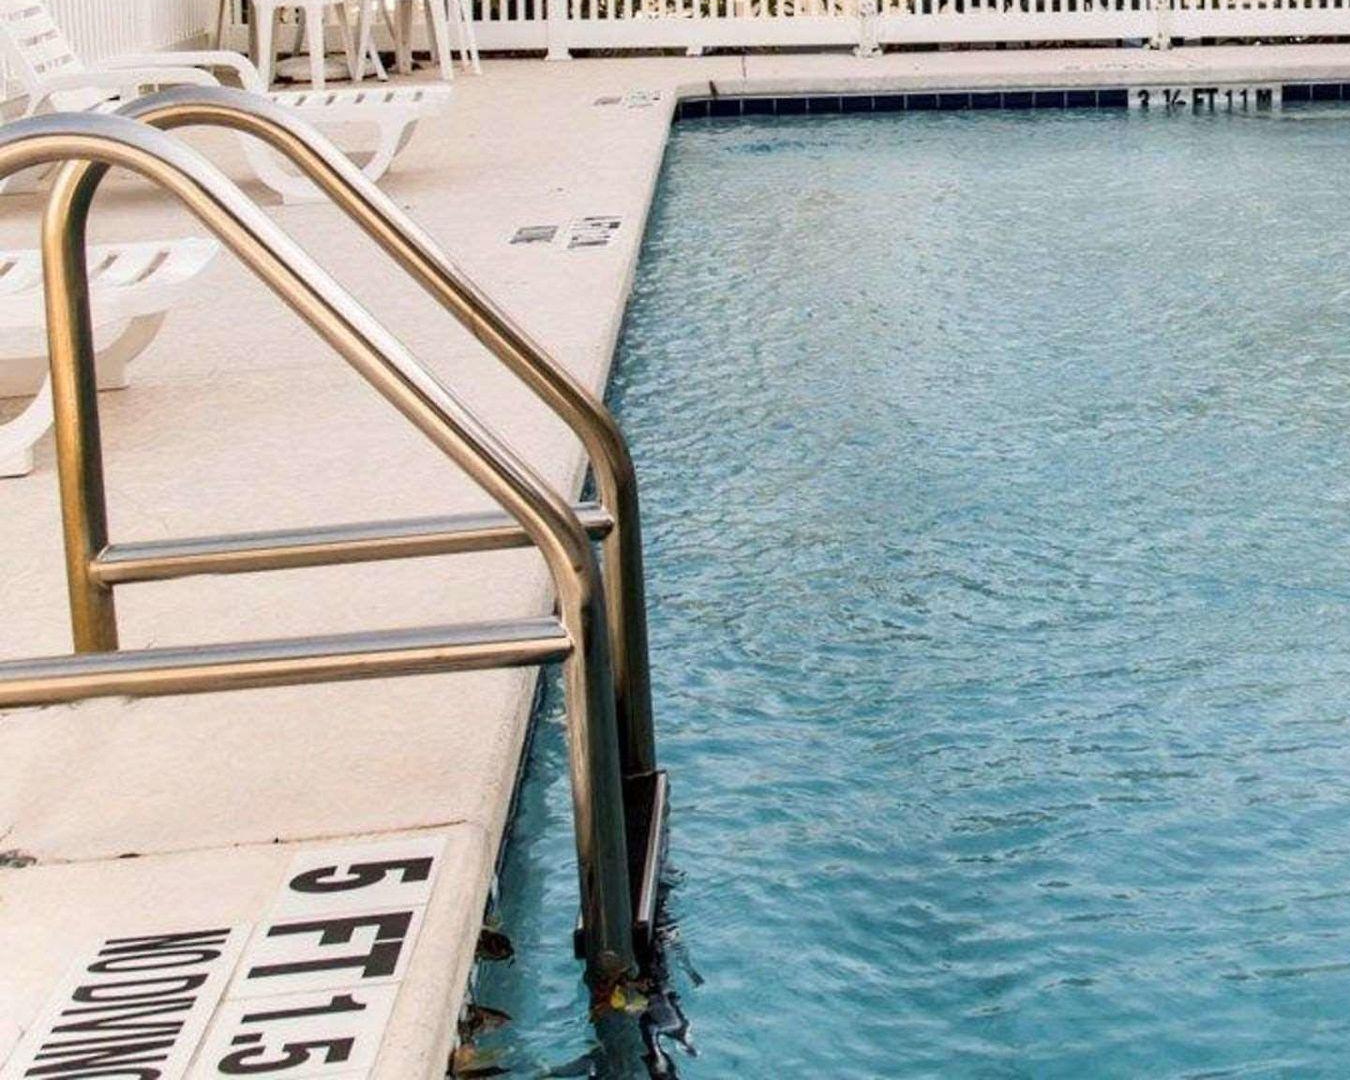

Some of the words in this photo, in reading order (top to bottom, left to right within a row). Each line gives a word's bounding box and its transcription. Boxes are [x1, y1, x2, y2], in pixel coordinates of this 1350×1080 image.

[289, 857, 434, 893] 5
[87, 928, 231, 973] NO
[247, 911, 413, 979] FT
[24, 973, 209, 1080] DIVIN
